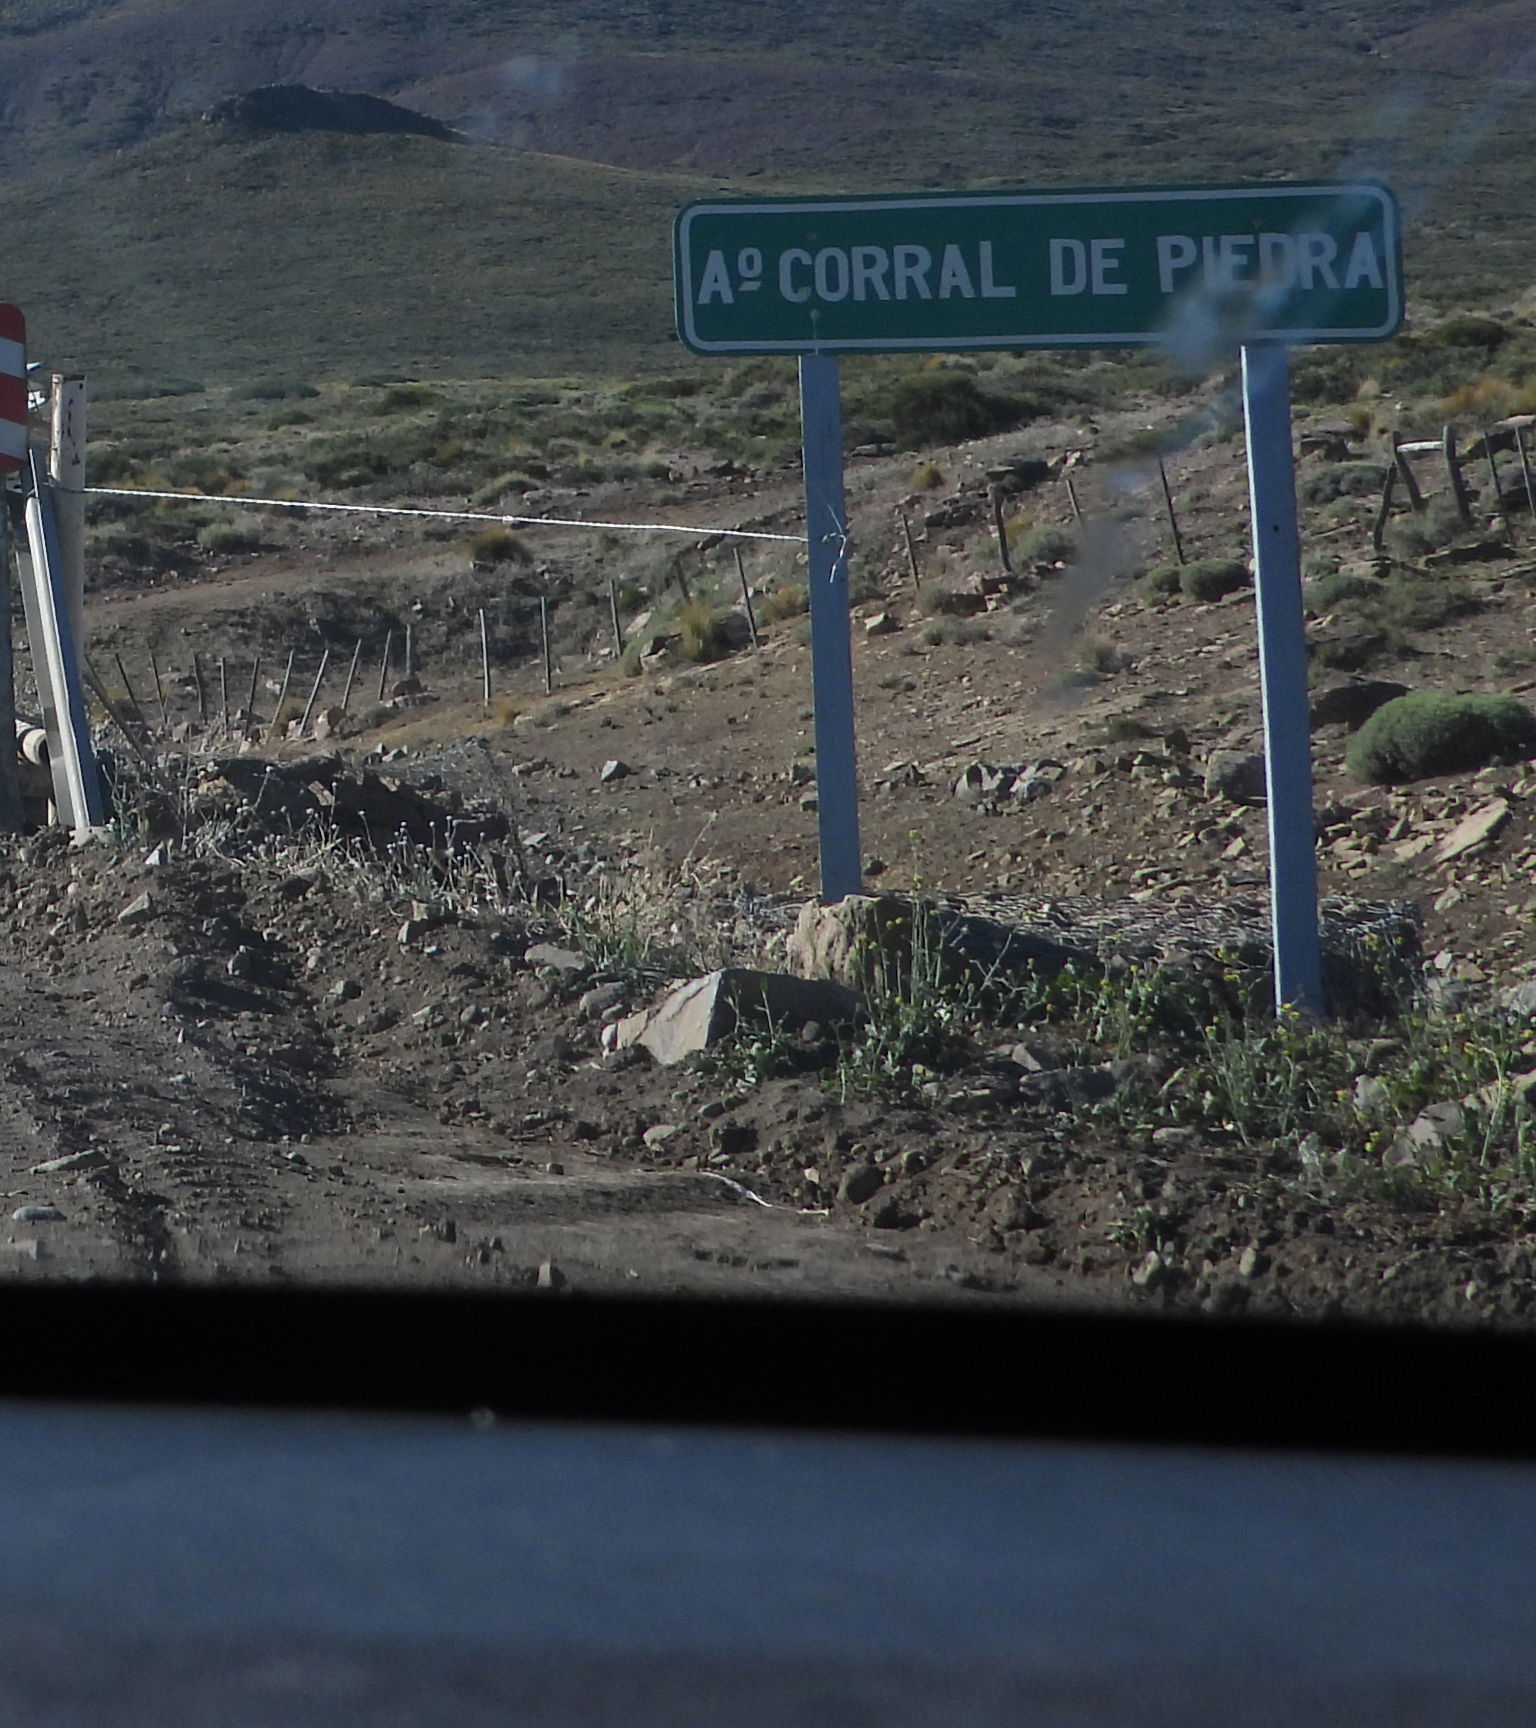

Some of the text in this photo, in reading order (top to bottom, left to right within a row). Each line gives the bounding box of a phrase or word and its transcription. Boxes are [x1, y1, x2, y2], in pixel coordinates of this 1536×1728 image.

[778, 240, 1017, 303] CORRAL
[1049, 238, 1126, 295] DE
[1156, 231, 1385, 294] PIEDRA
